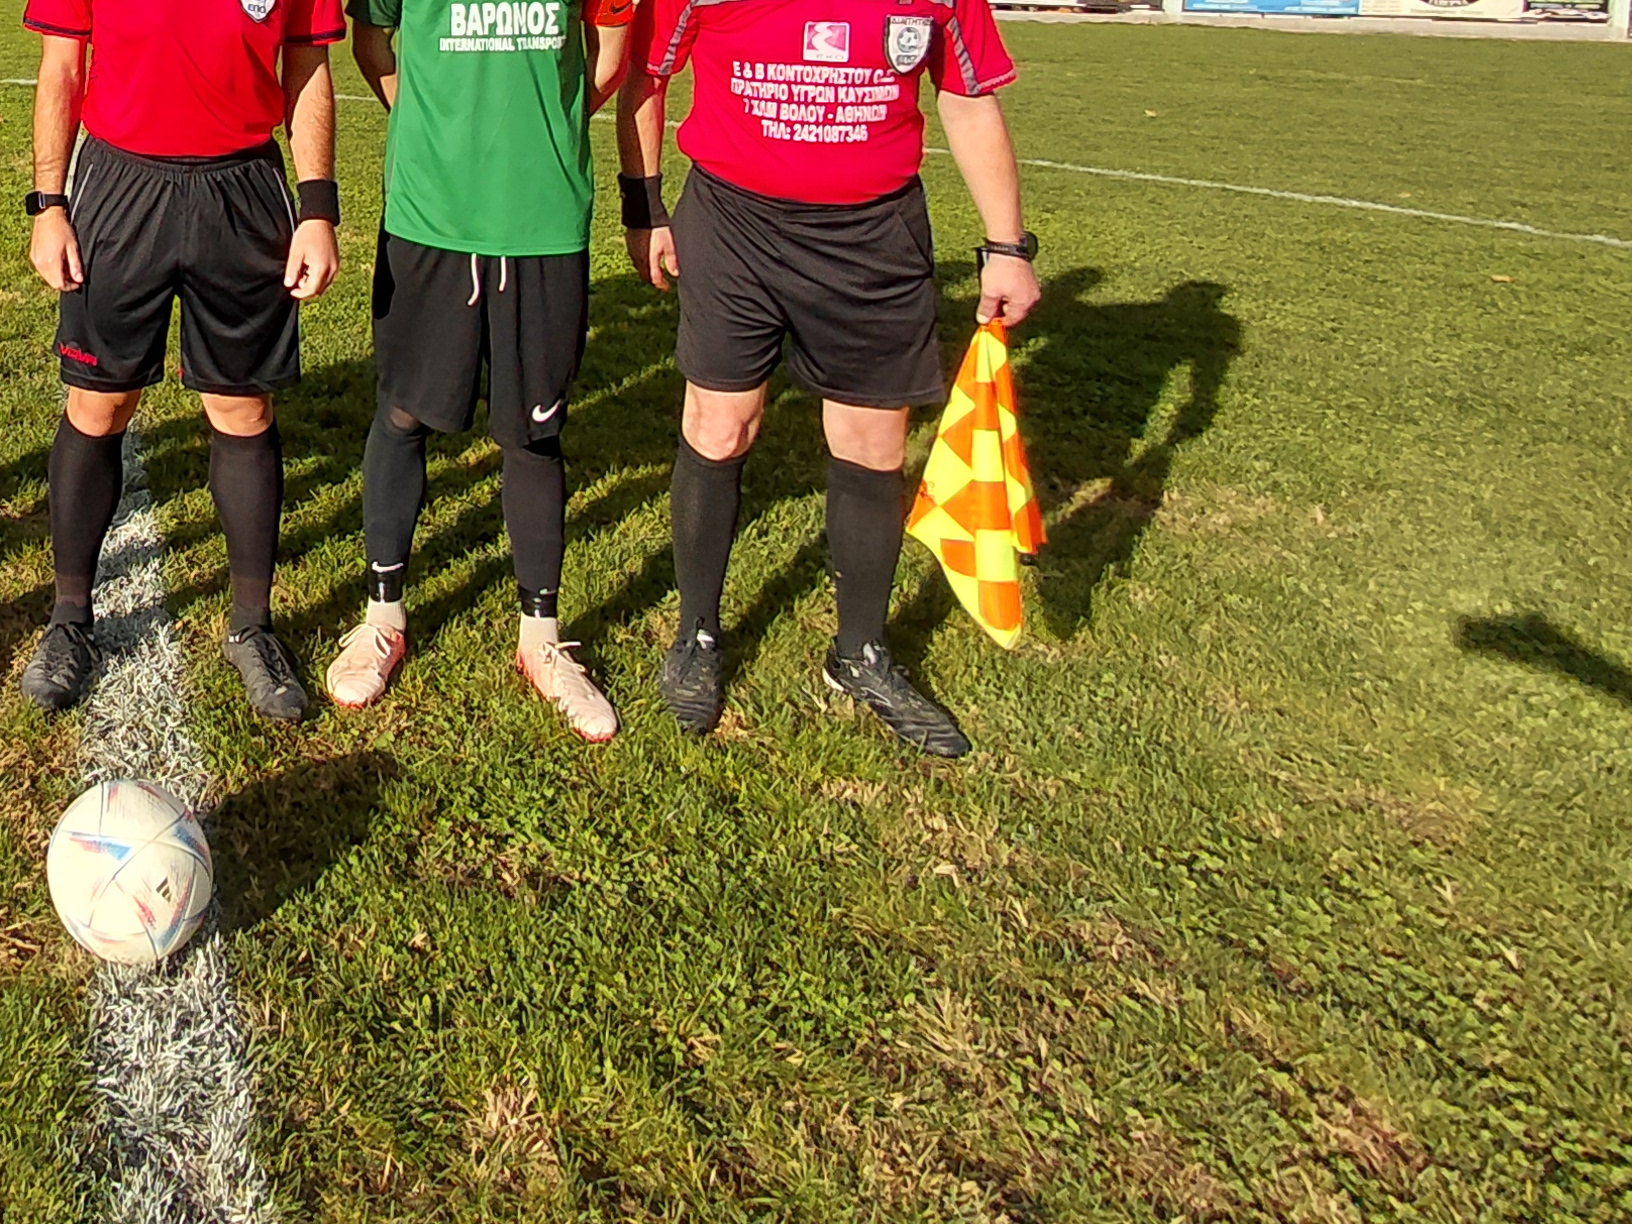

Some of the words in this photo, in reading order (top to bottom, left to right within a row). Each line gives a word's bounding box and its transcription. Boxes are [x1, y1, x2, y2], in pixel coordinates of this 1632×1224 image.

[248, 4, 266, 14] ΕΠΟ
[451, 2, 560, 36] ΒΑΡΩΝΟΣ
[439, 38, 515, 52] INTERNATIONAL
[743, 62, 753, 79] &
[767, 63, 873, 85] ΚΟΝΤΟΧΡΗΣΤΟΥ
[731, 77, 788, 101] ΠΡΑΤΗΡΙΟ
[791, 84, 835, 103] ΥΓΡΩΝ
[837, 84, 900, 104] ΚΑΥΣΙΜΩΝ
[779, 103, 825, 123] ΒΟΛΟΥ
[835, 104, 888, 124] ΑΘΗΝΩΝ
[793, 123, 868, 144] 2421087346
[58, 340, 97, 366] VOVA
